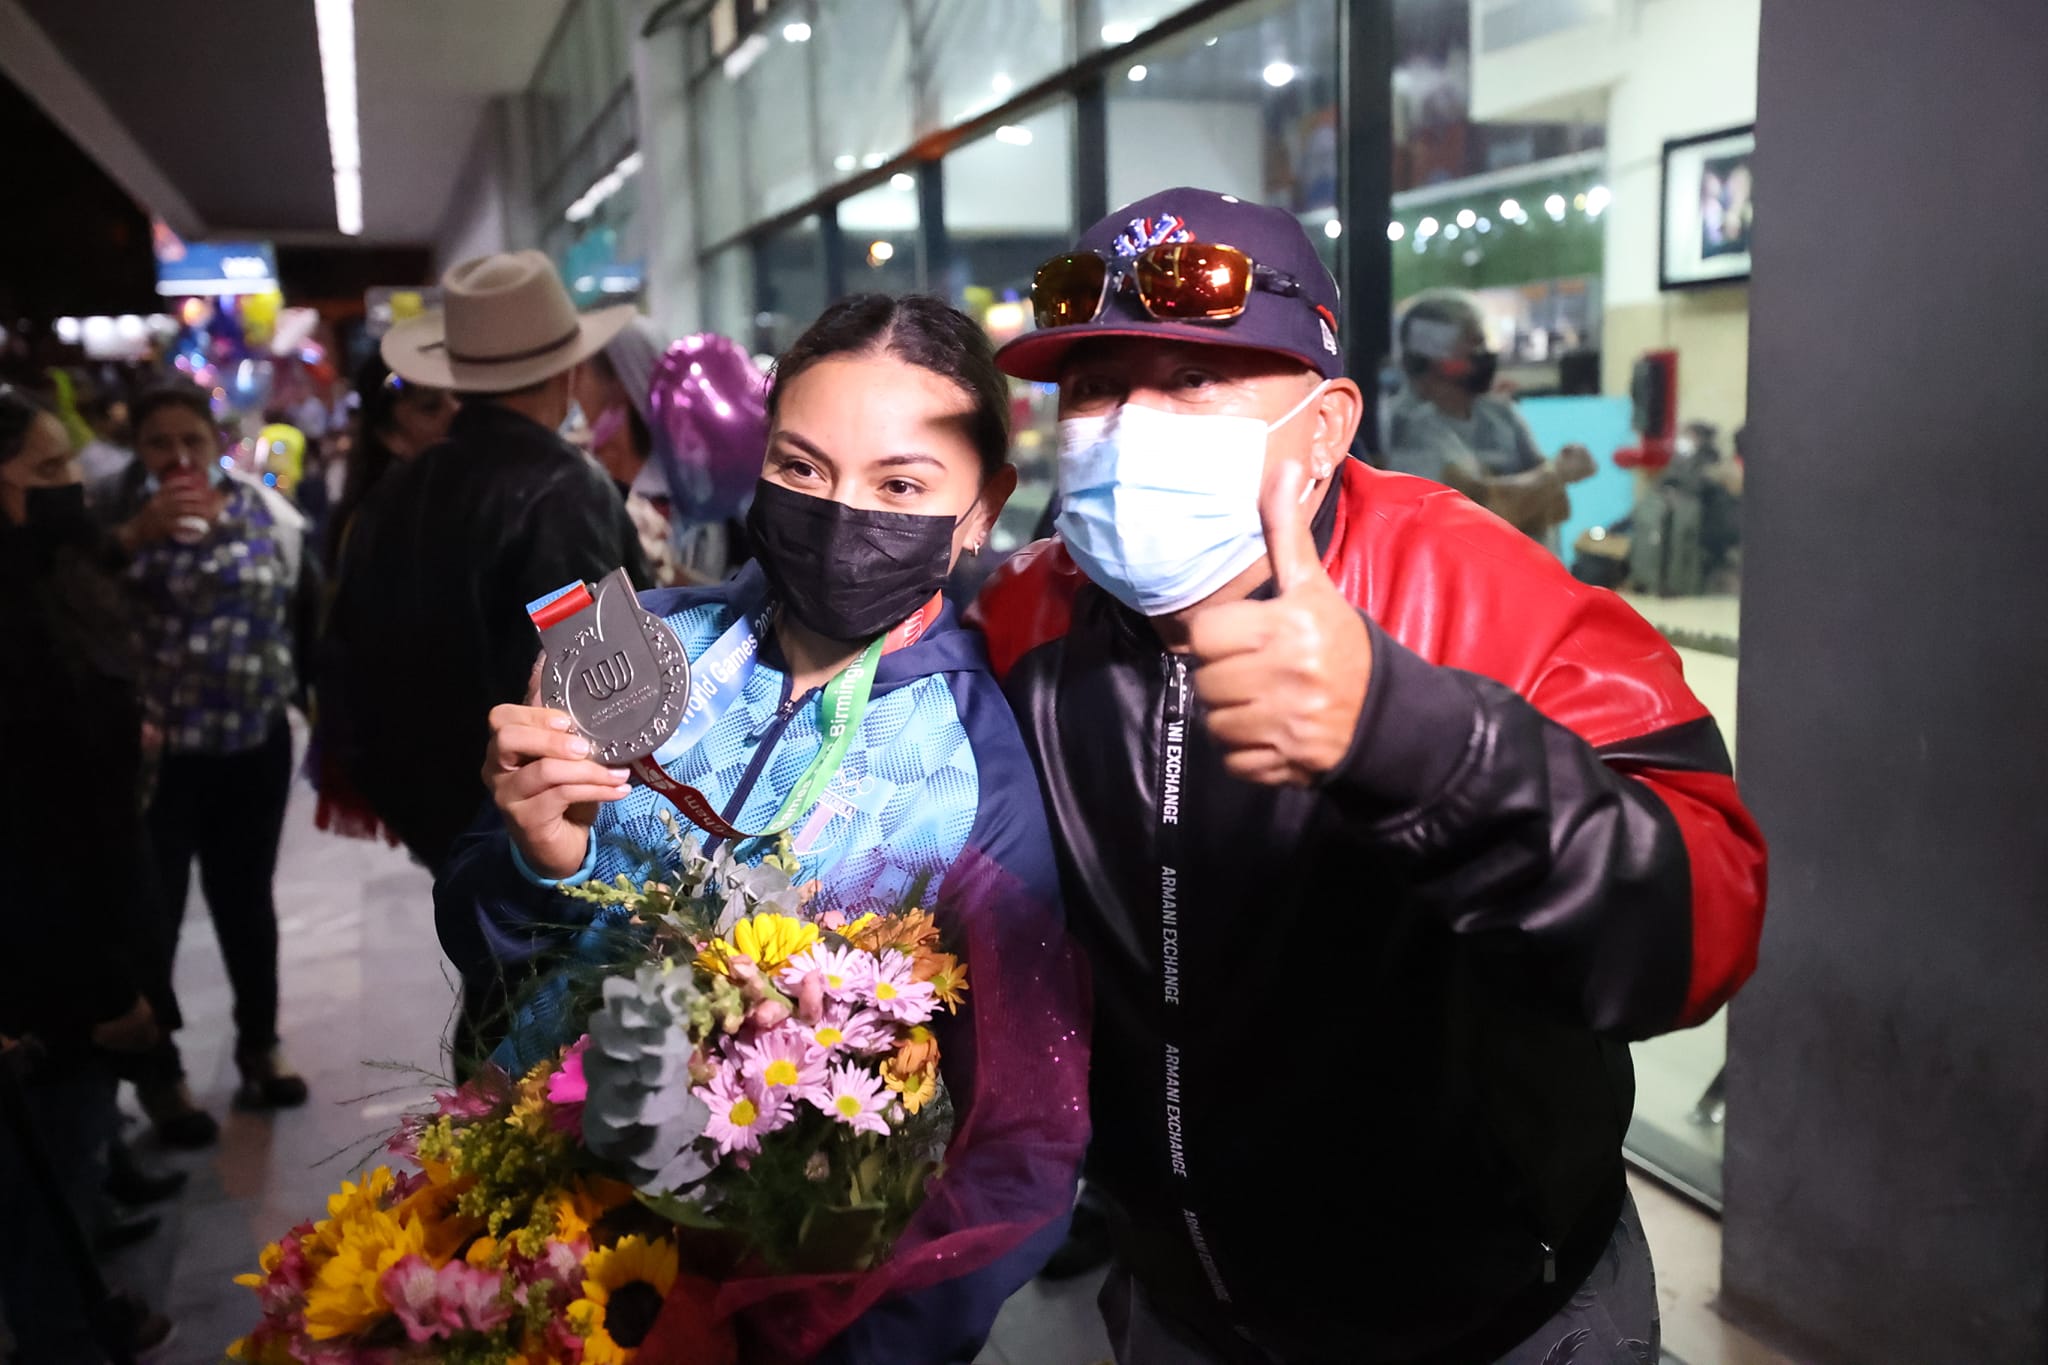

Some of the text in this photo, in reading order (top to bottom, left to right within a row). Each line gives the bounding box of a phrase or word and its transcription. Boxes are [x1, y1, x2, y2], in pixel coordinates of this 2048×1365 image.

[709, 633, 758, 684] Games
[830, 646, 871, 737] Birmingh
[1163, 745, 1183, 825] EXCHANGE
[1162, 866, 1179, 1005] ARMANI EXCHANGE
[1166, 1043, 1187, 1178] ARMANI EXCHANGE
